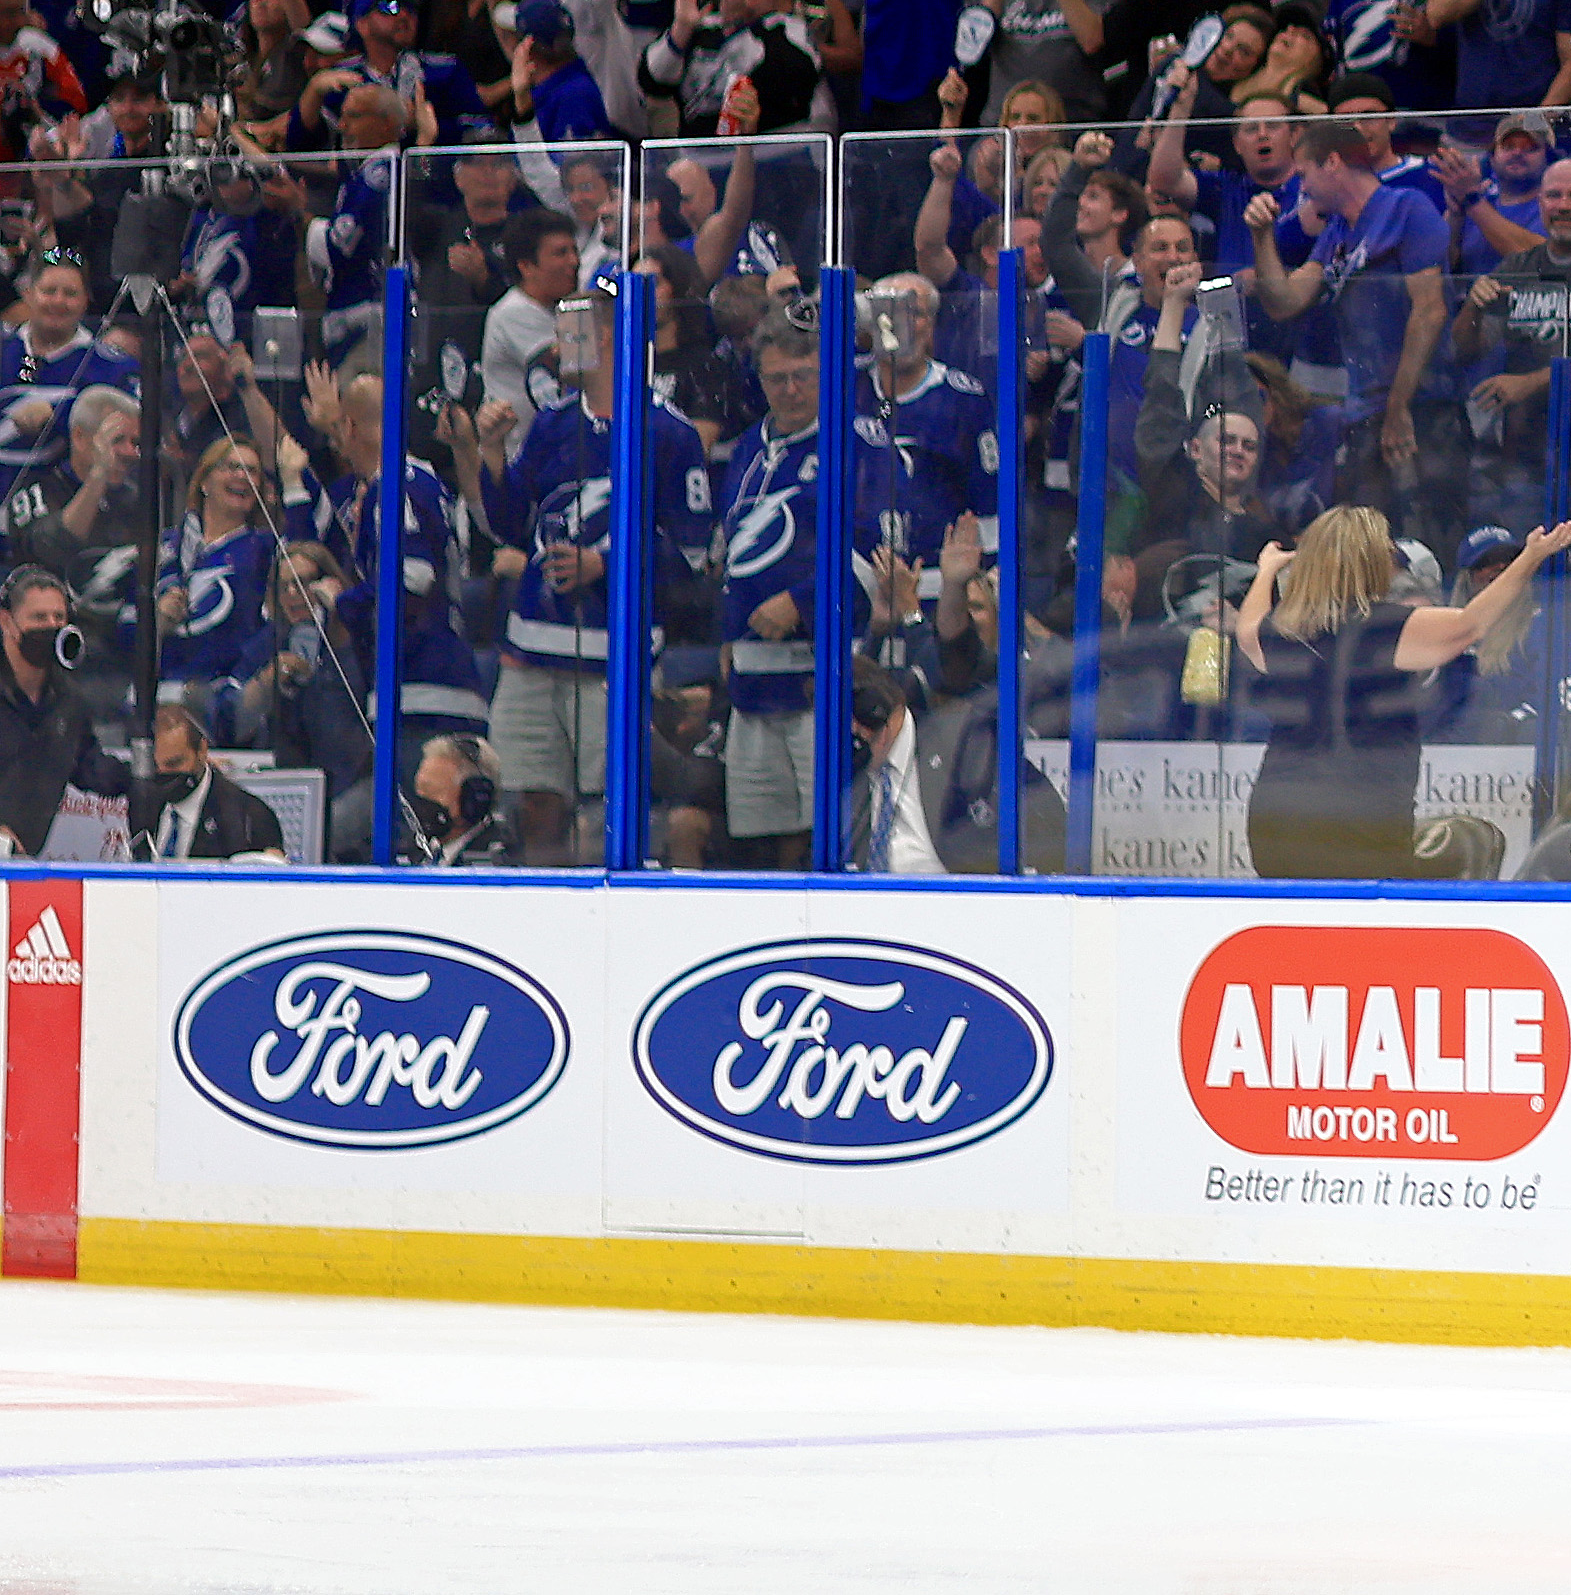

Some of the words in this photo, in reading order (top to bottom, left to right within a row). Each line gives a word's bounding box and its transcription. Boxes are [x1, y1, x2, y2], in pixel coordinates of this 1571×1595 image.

[12, 481, 49, 527] 91
[1425, 761, 1536, 808] kane's
[1103, 831, 1208, 869] kane's
[8, 957, 83, 985] adidas
[250, 961, 490, 1111] Ford
[713, 971, 968, 1125] Ford
[1205, 983, 1546, 1095] AMALIE
[1287, 1106, 1398, 1143] MOTOR
[1405, 1108, 1459, 1144] OIL
[1204, 1165, 1293, 1203] Better
[1301, 1170, 1364, 1206] than
[1374, 1171, 1391, 1206] it
[1400, 1172, 1453, 1208] has
[1465, 1175, 1490, 1209] to
[1500, 1173, 1538, 1210] be
